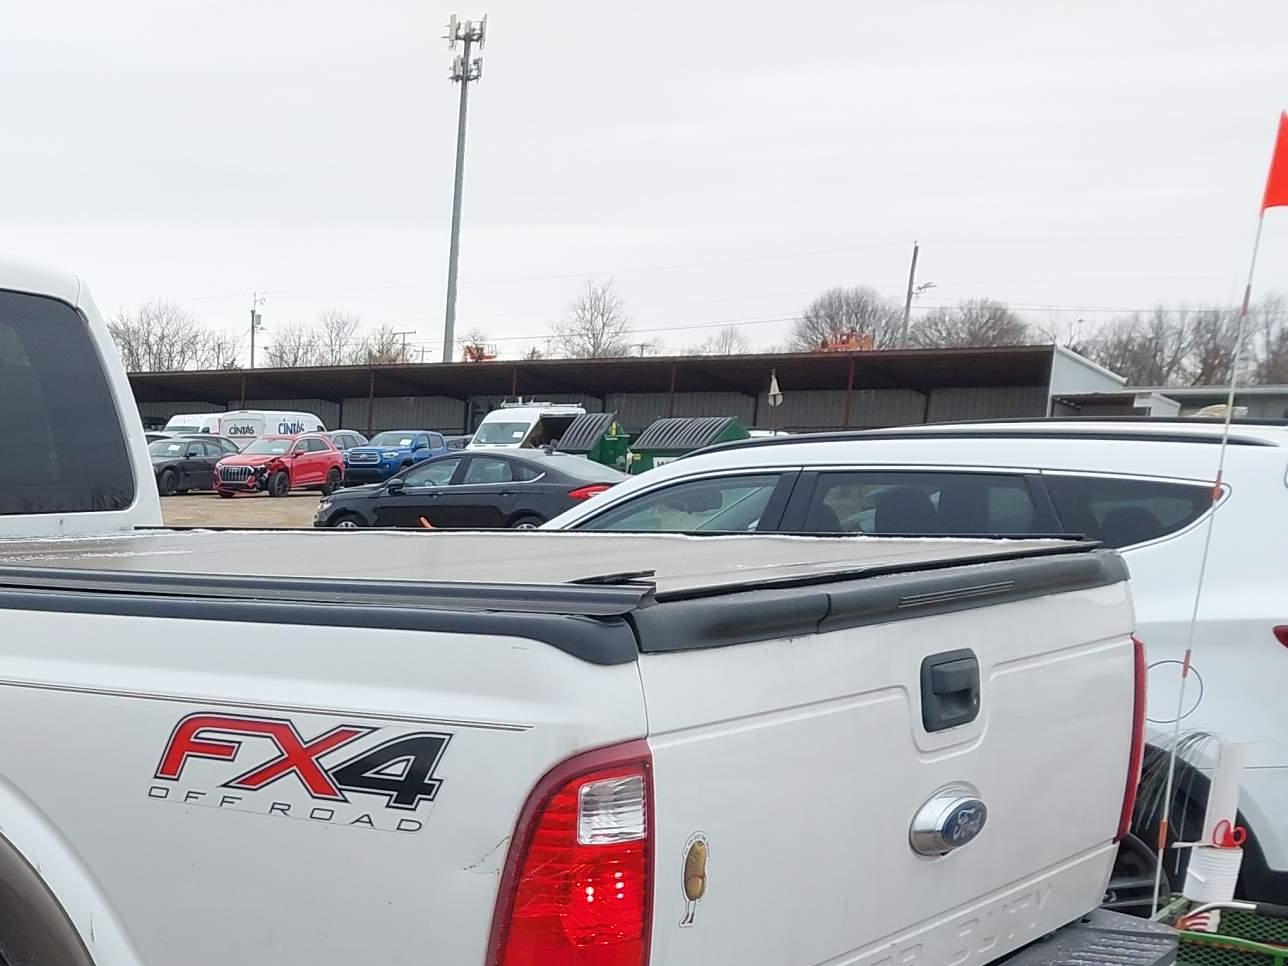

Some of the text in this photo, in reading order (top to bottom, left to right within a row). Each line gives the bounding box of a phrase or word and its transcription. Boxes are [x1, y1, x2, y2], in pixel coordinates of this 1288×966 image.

[229, 424, 255, 435] CINTAS
[278, 418, 305, 435] CINTAS
[152, 711, 454, 811] FX4
[148, 786, 423, 832] OFF ROAD
